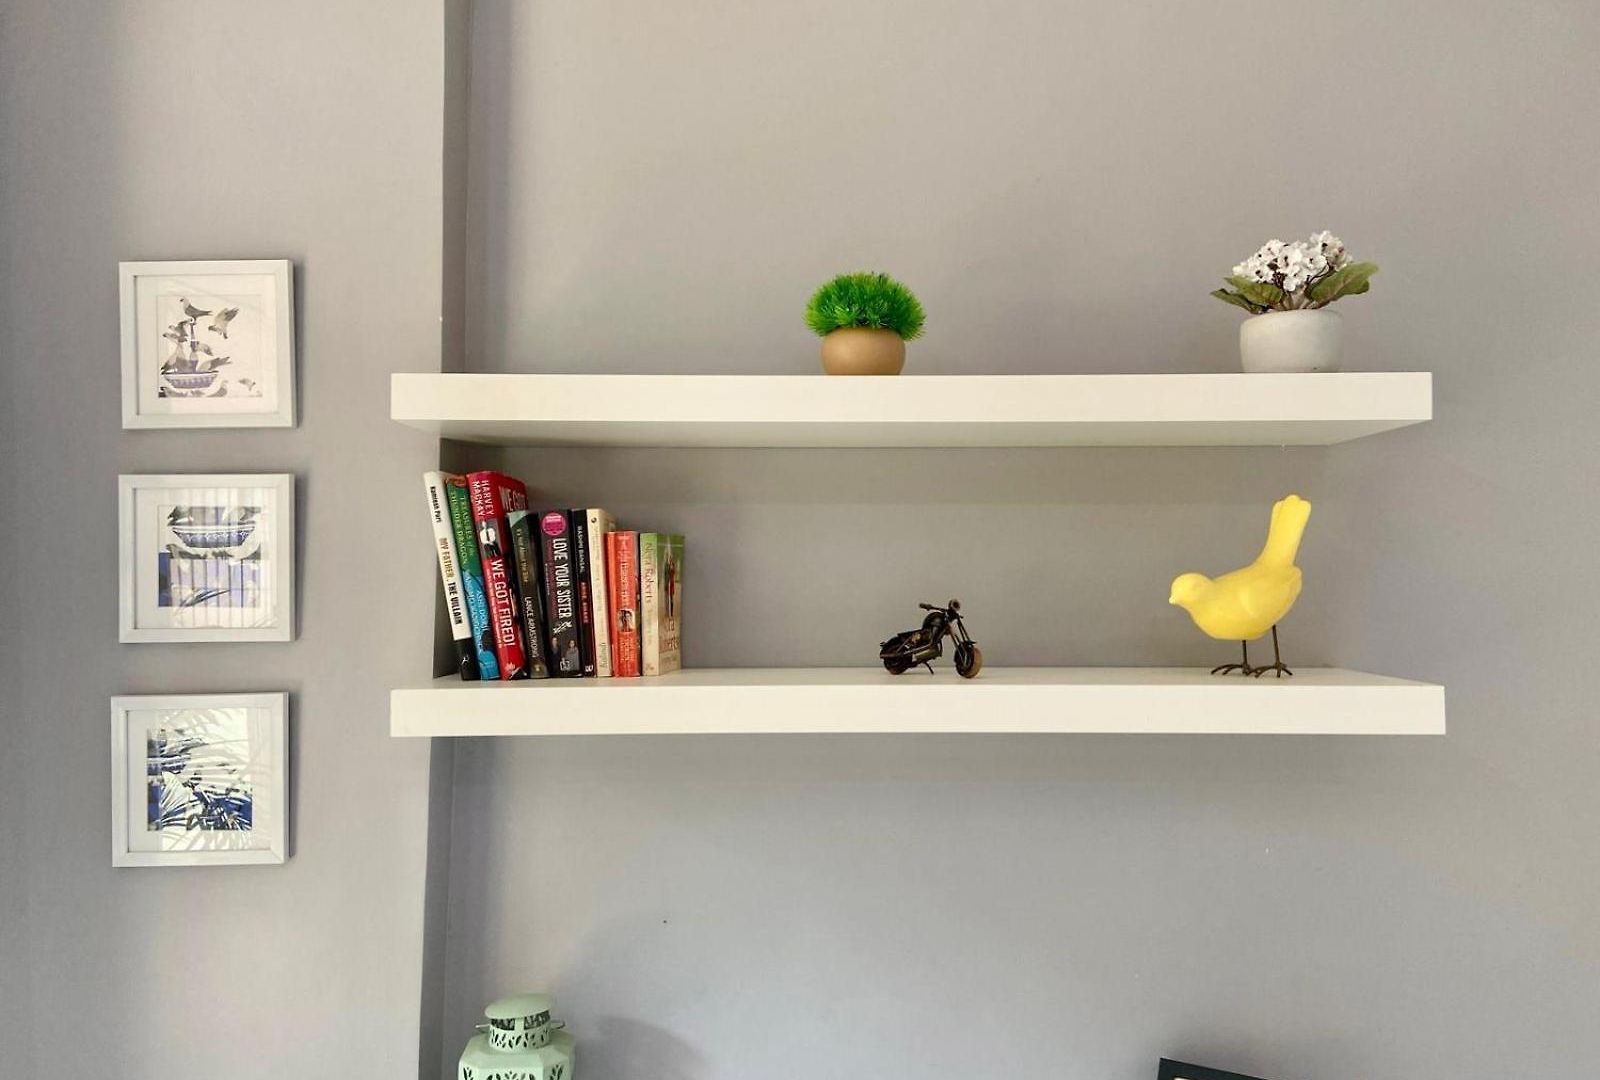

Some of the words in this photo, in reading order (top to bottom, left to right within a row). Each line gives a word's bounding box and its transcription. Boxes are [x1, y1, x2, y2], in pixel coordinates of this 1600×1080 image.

[472, 480, 486, 516] MACKAY
[481, 479, 495, 515] HARVEY
[439, 536, 449, 549] MY
[458, 531, 470, 564] DRAGON
[552, 537, 568, 560] LOVE
[491, 559, 505, 579] WE
[554, 563, 570, 587] YOUR
[448, 582, 458, 595] THE
[495, 581, 509, 606] GOT
[645, 568, 656, 603] Roberts
[451, 596, 464, 624] VILLAIN
[524, 595, 536, 617] LANCE
[556, 589, 573, 619] SISTER
[499, 608, 515, 646] FIRED!
[526, 617, 542, 658] ARMSTRONG
